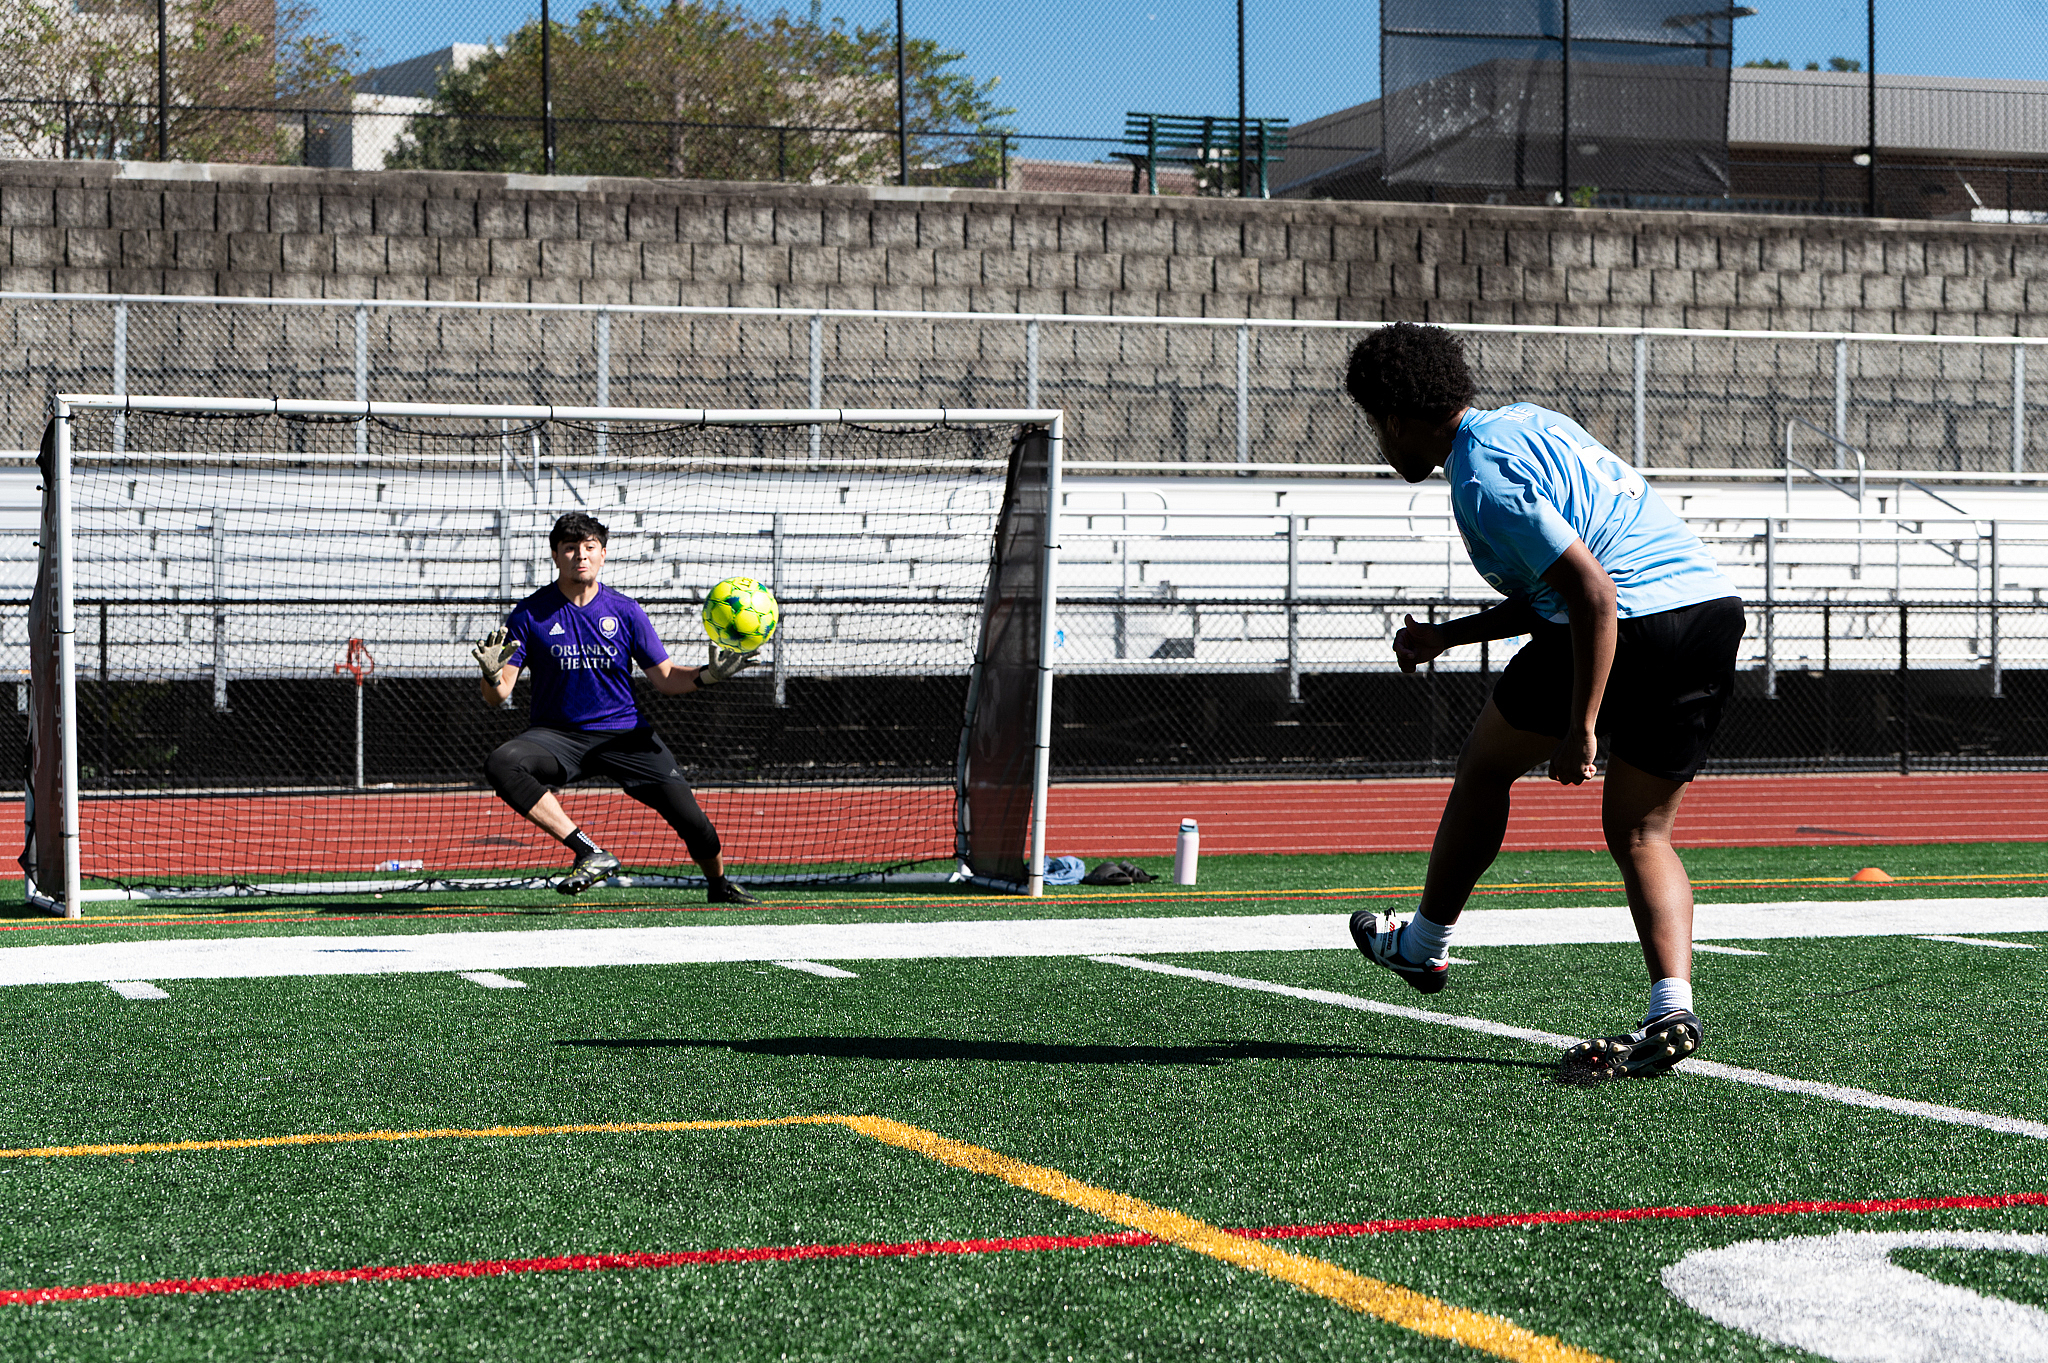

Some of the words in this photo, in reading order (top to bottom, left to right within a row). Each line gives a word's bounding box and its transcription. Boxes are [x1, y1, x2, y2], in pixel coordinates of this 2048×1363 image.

[1544, 424, 1646, 500] 6
[550, 643, 618, 657] ORLANDO
[560, 657, 611, 671] HEALTH
